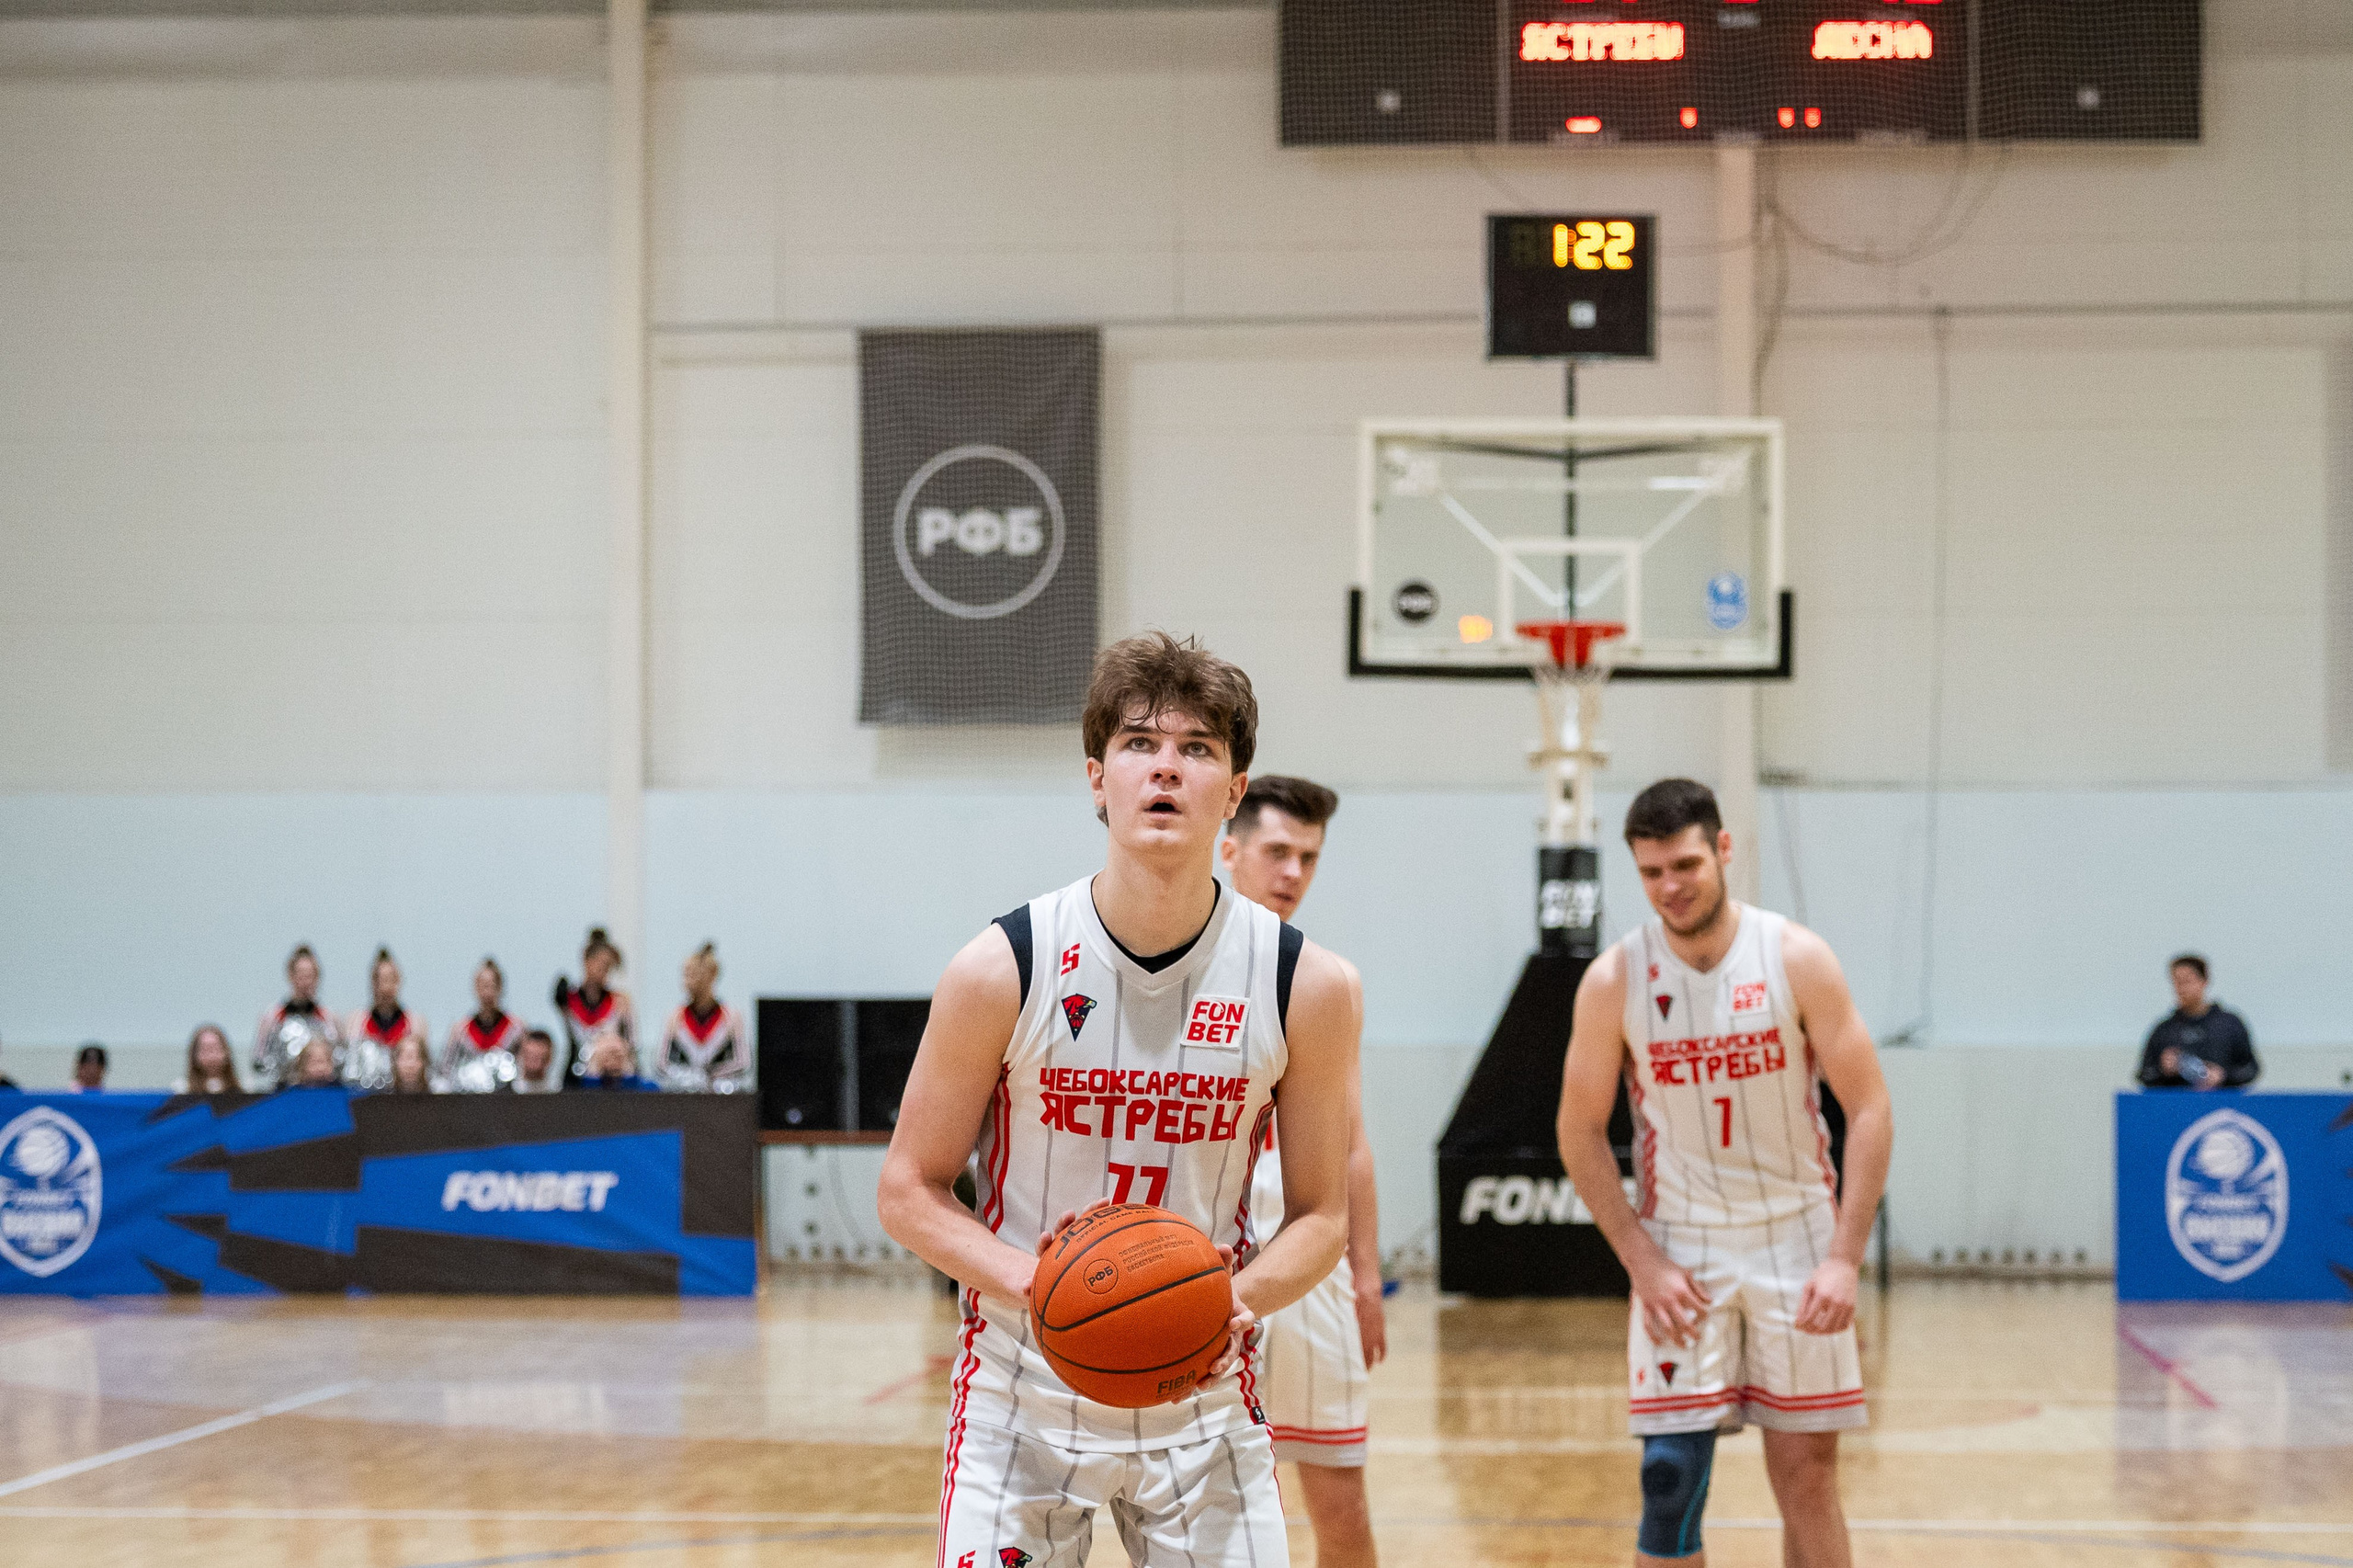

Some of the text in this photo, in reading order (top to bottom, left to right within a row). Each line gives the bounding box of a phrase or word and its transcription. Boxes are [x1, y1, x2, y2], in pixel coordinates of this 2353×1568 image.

[918, 507, 1042, 557] РФБ
[1192, 1001, 1245, 1023] FON
[1187, 1022, 1239, 1043] BET
[1652, 1045, 1785, 1084] ЯСТРЕБЫ
[1040, 1068, 1249, 1101] ЧЕБОКСАРСКИЕ
[1040, 1092, 1245, 1143] ЯСТРЕБЫ
[441, 1170, 620, 1212] FONBET
[1087, 1267, 1114, 1287] РФБ
[1157, 1370, 1196, 1393] FIBA
